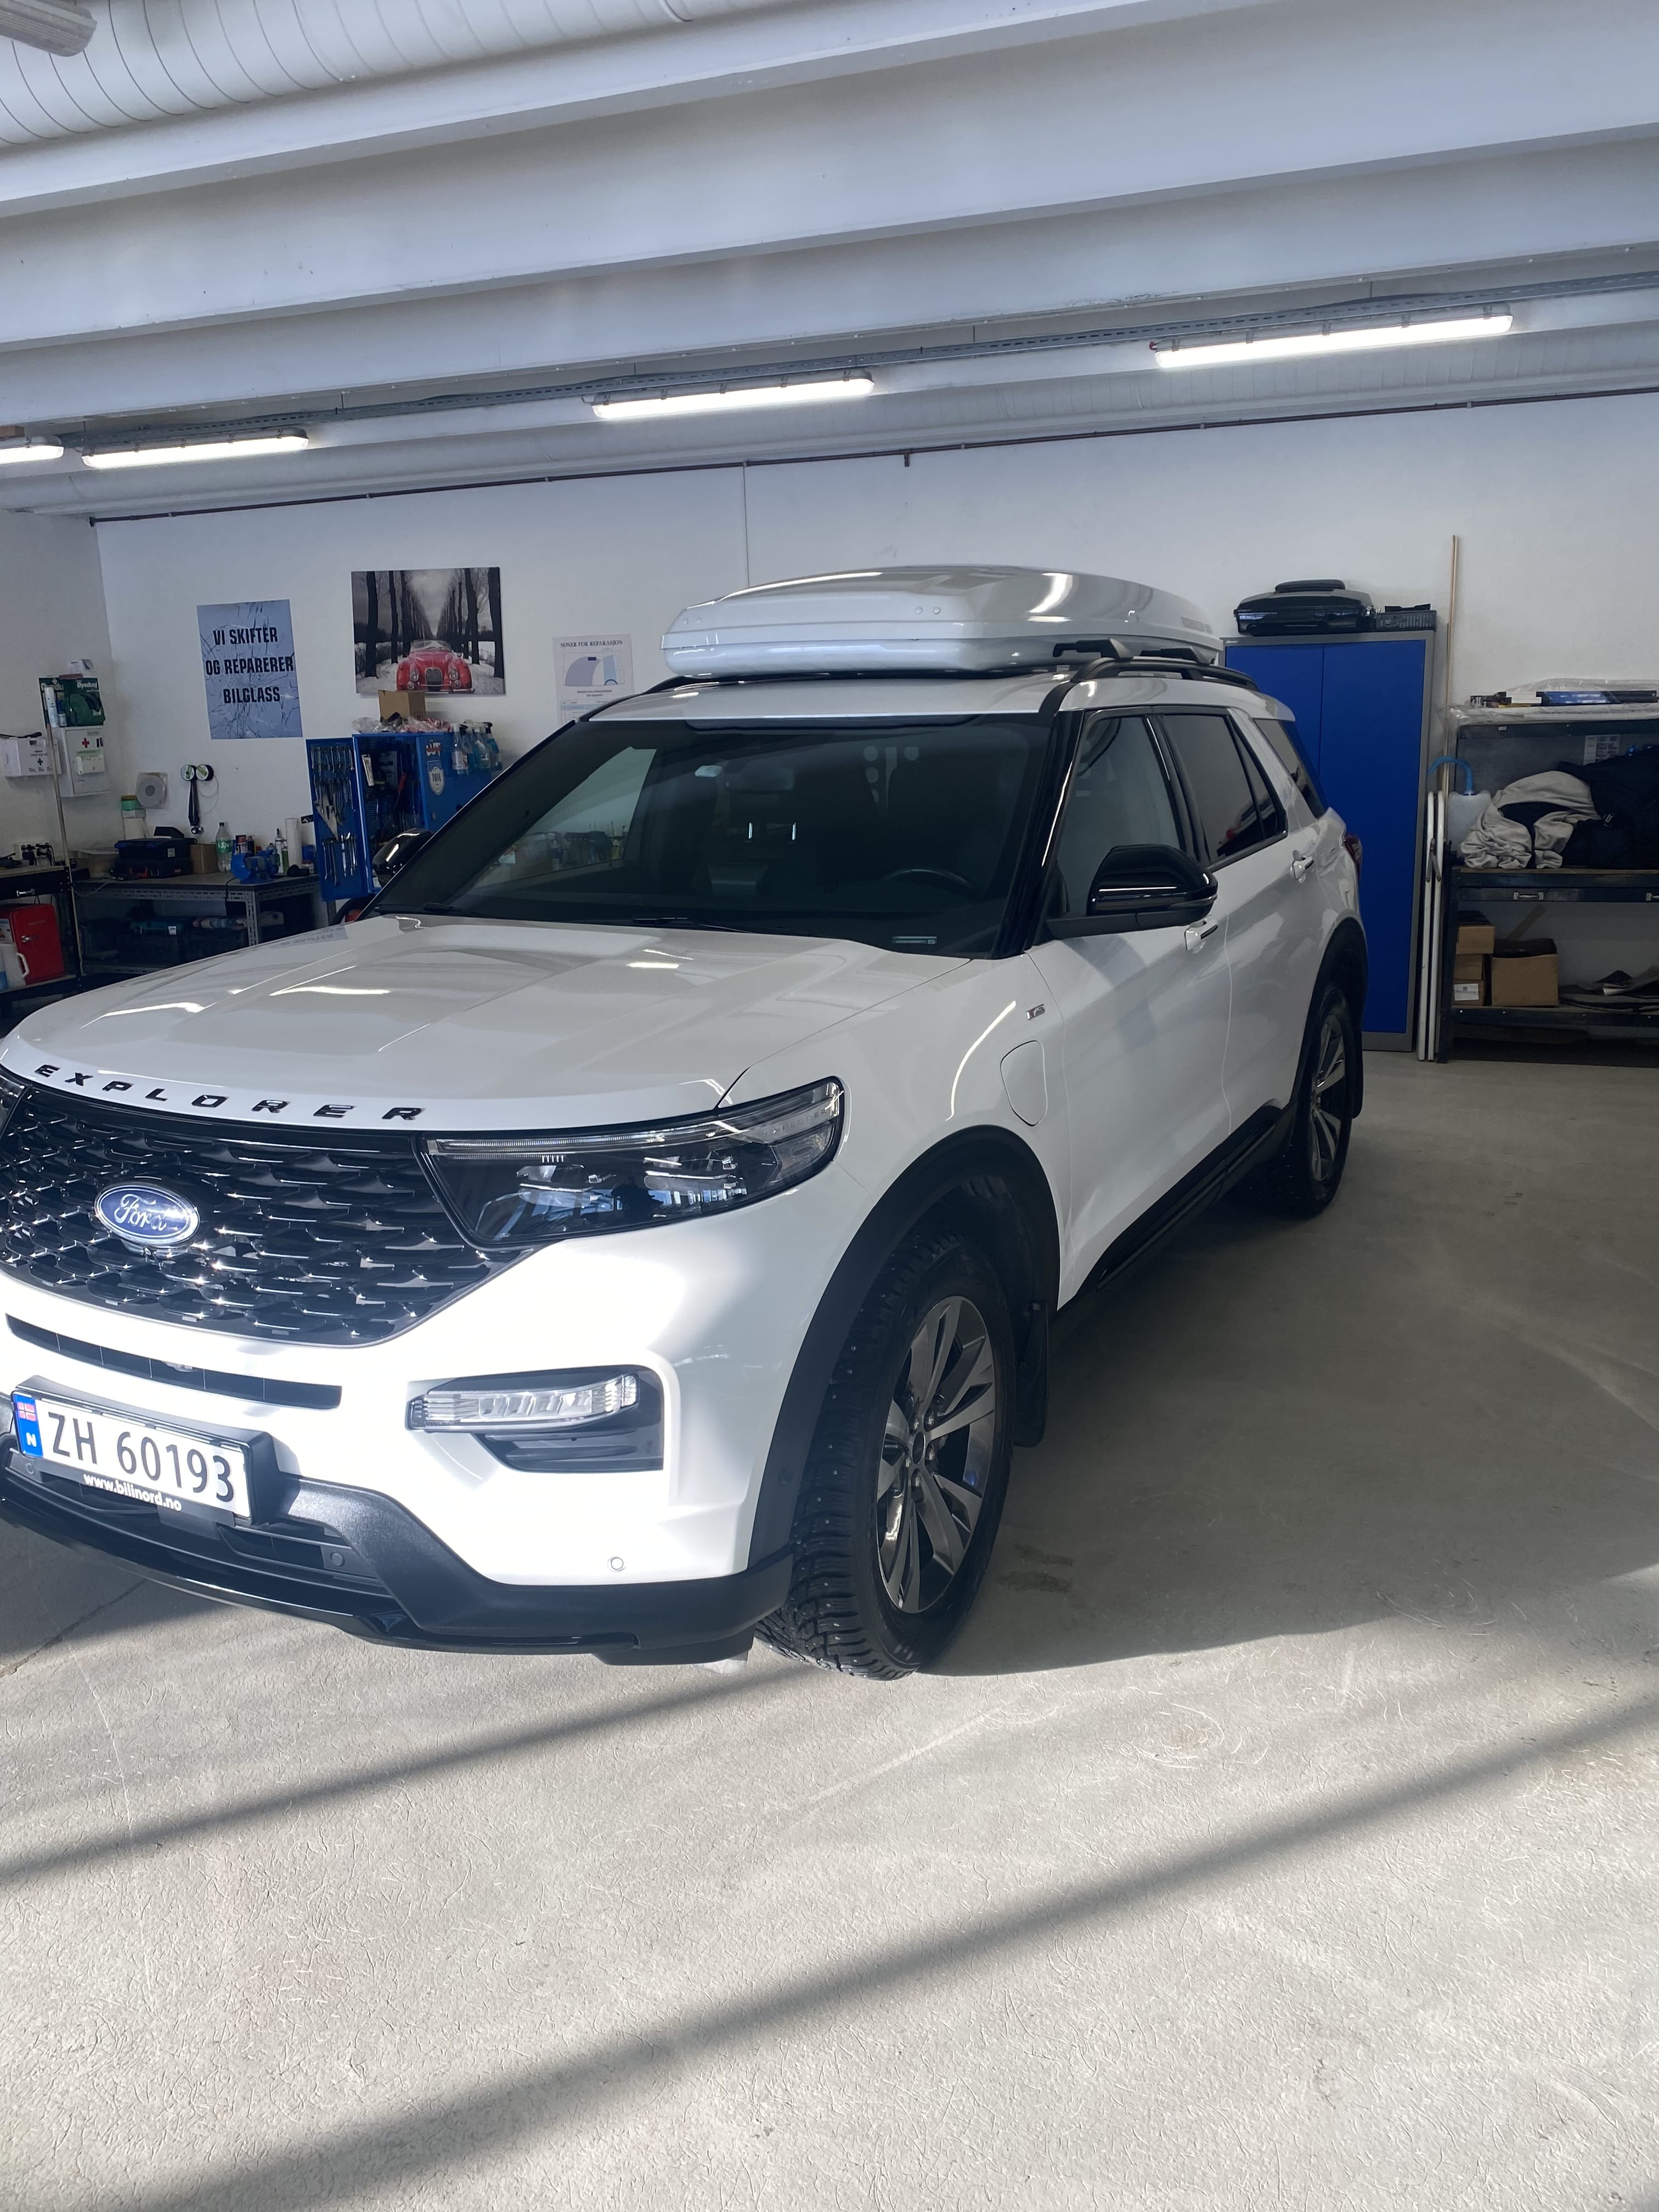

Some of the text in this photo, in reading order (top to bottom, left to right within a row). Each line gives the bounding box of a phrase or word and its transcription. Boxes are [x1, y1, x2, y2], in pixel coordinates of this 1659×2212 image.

[213, 627, 278, 645] VI SKIFTER
[205, 656, 294, 675] OG REPARERER
[223, 687, 280, 703] BILGLASS
[34, 1064, 426, 1120] EXPLORER
[114, 1193, 167, 1232] Ford
[26, 1432, 37, 1447] N
[48, 1412, 235, 1503] ZH 60193
[83, 1474, 182, 1511] www.bilinord.no
